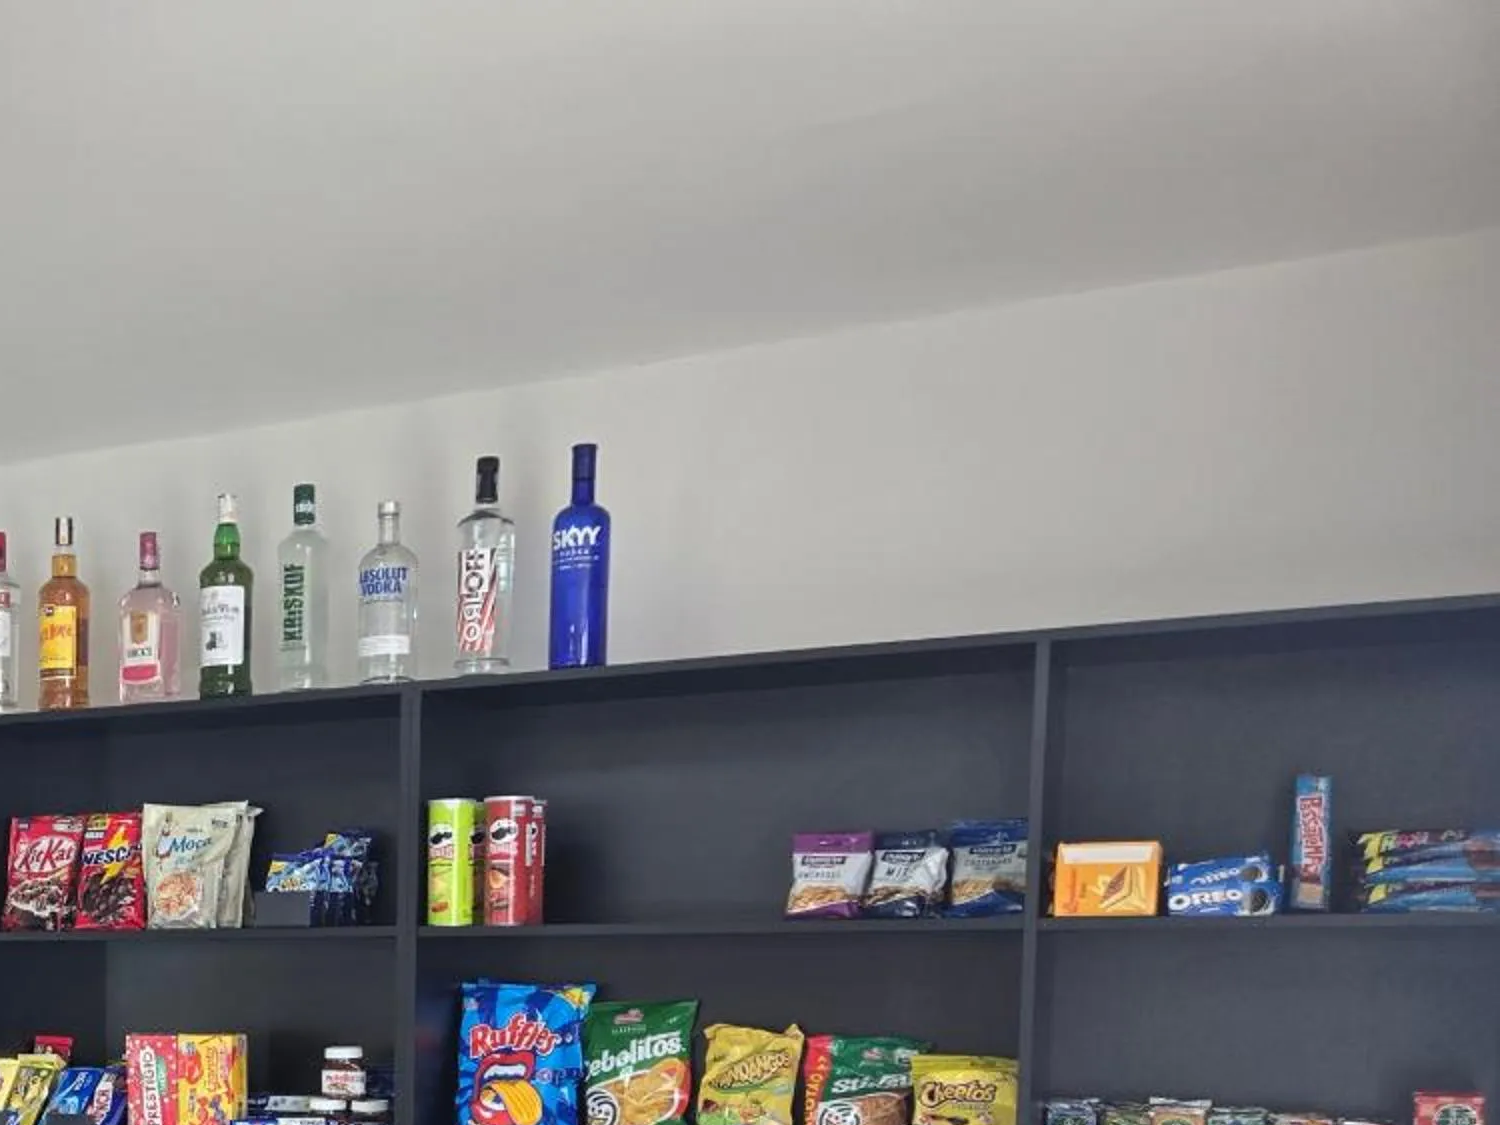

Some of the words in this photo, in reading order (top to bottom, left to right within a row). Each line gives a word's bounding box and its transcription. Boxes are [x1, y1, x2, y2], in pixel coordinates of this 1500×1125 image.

[553, 525, 601, 550] SKYY
[1168, 890, 1244, 912] OREO
[469, 1013, 555, 1059] Ruffles
[920, 1081, 997, 1107] Cheetos
